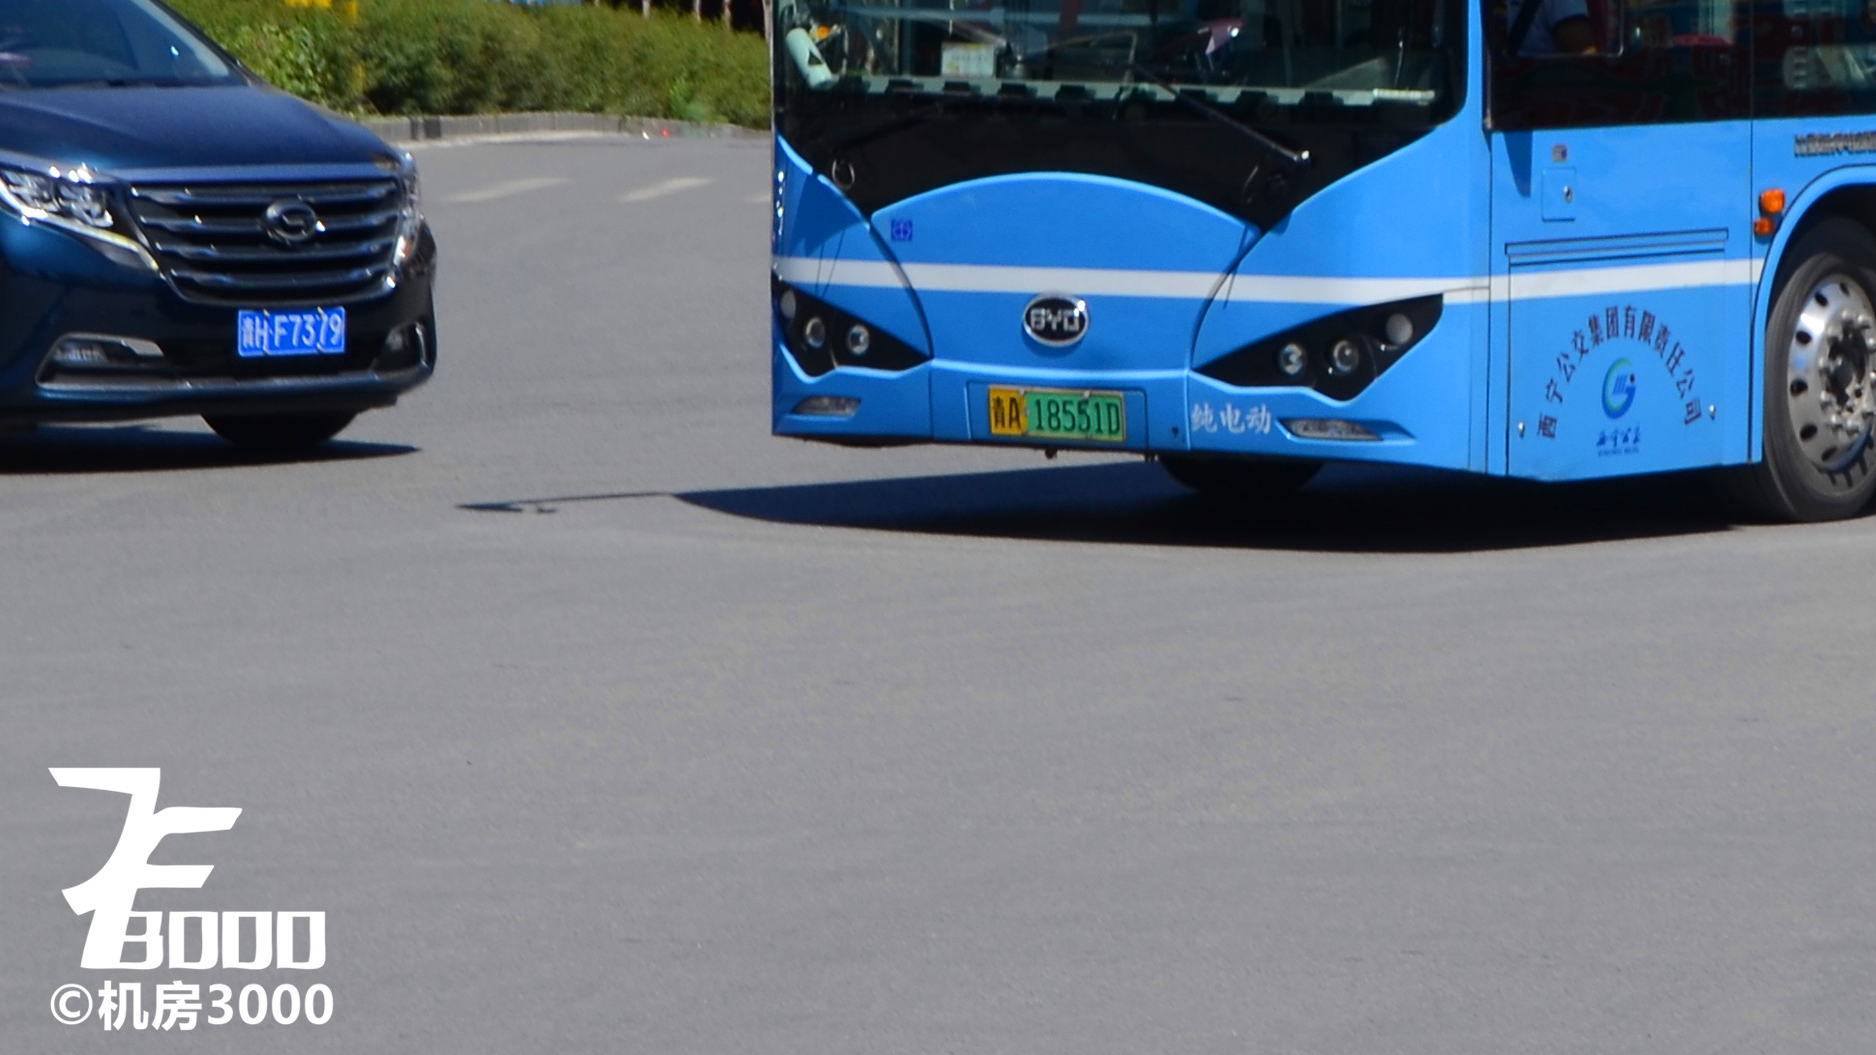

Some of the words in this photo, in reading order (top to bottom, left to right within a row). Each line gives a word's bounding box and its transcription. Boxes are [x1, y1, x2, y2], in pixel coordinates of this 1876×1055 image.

[1030, 308, 1080, 332] BYD
[1537, 305, 1703, 440] 西宁公交集团有限责任公司
[1190, 402, 1272, 435] 纯电动
